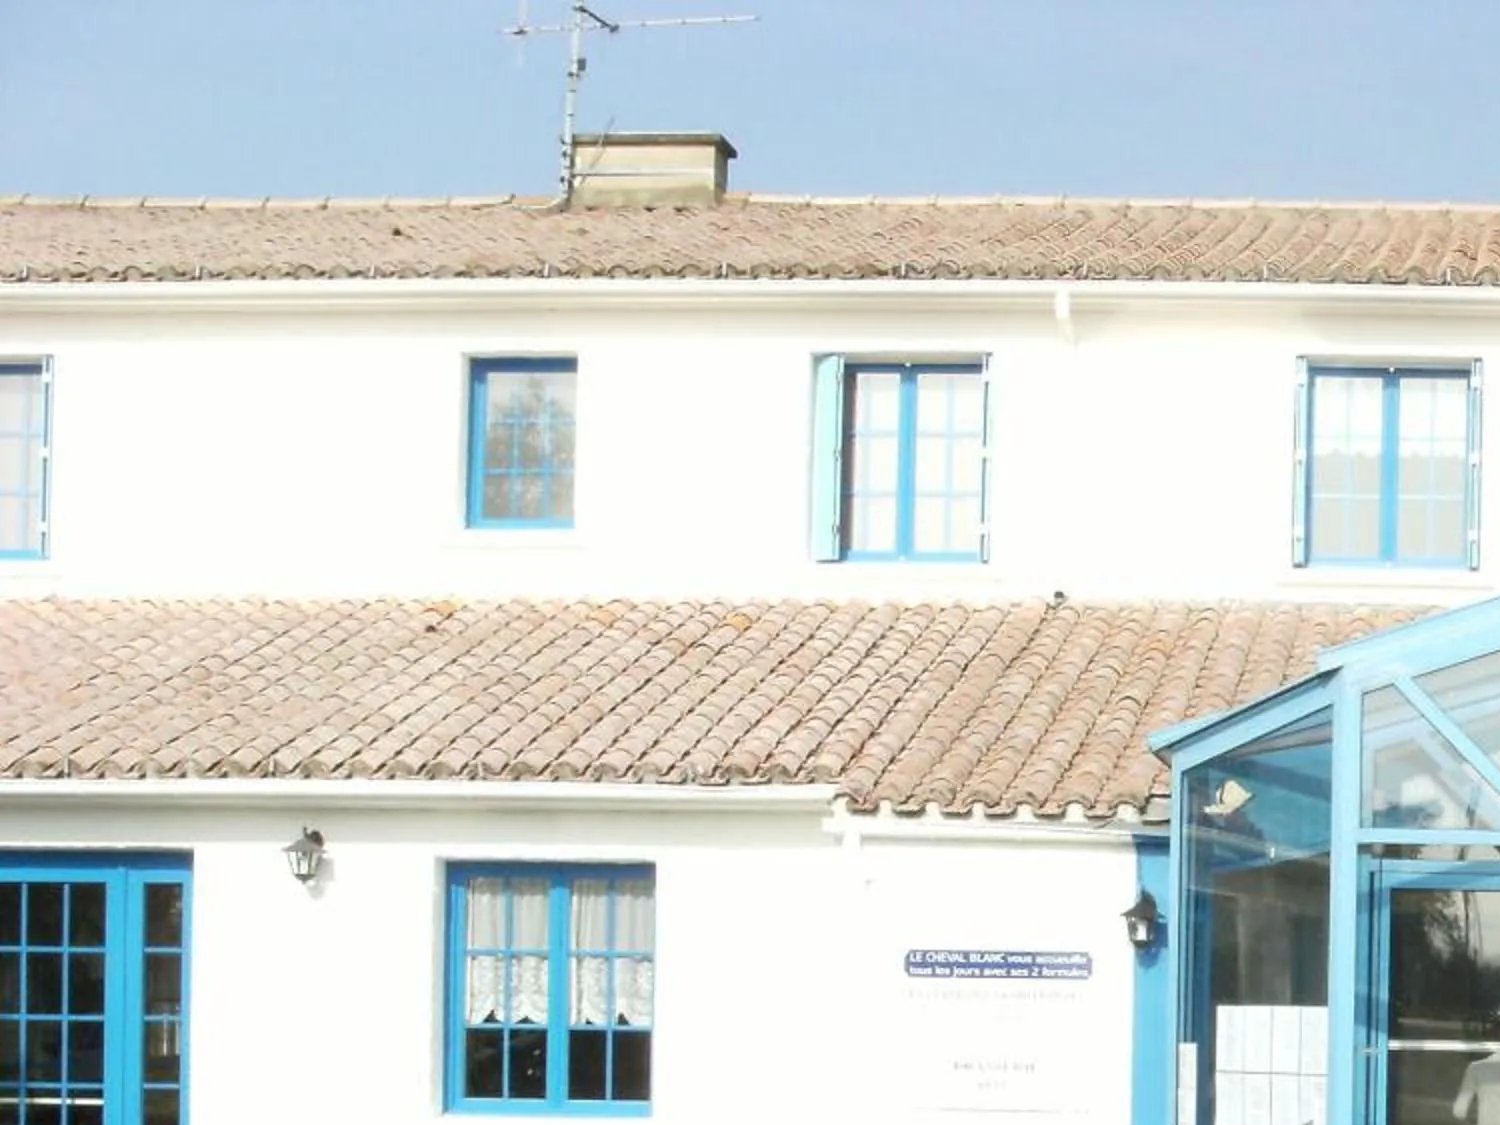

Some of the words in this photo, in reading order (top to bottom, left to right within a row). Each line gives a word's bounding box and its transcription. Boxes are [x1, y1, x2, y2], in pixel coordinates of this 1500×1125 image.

[909, 952, 923, 963] LE
[926, 952, 966, 963] CHEVAL
[970, 952, 1005, 964] BLANC
